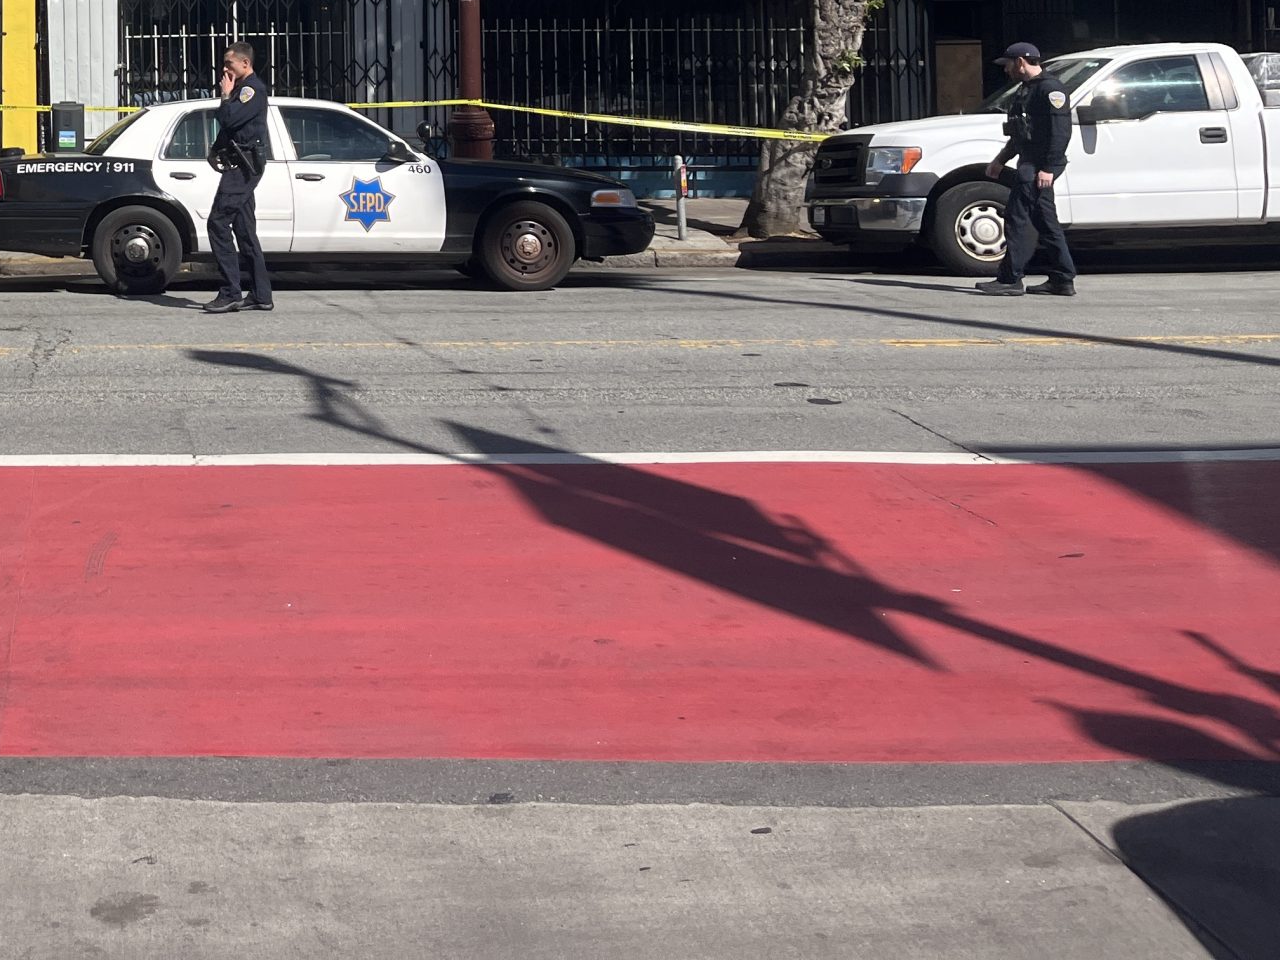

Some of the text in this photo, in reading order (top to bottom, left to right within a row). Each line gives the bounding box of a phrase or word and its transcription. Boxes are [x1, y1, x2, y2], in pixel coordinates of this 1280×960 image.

[16, 162, 135, 174] EMERGENCY 911
[407, 164, 432, 174] 460
